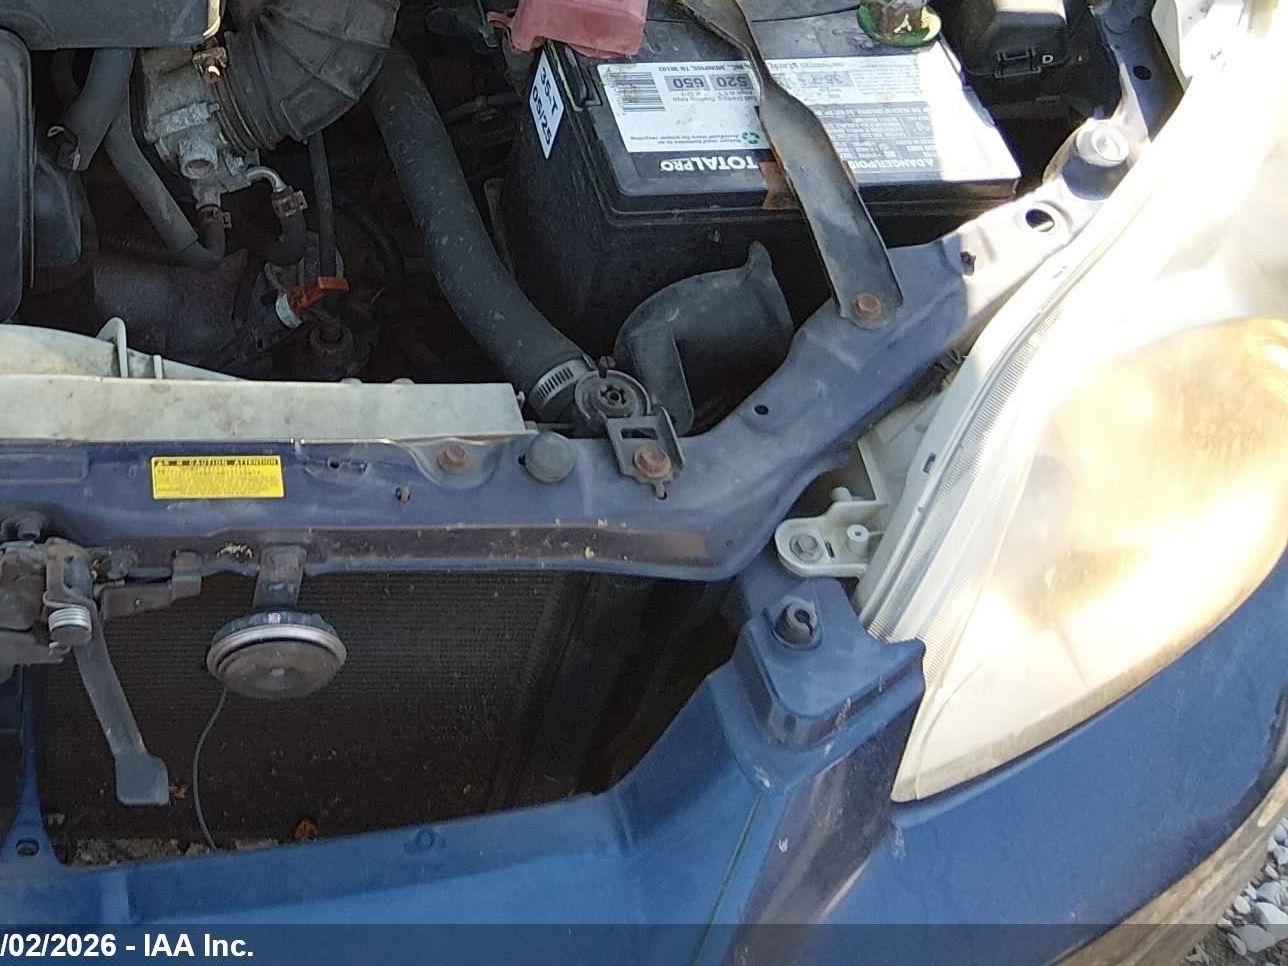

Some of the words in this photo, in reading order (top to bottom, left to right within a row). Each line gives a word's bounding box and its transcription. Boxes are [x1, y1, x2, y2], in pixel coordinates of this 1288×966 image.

[672, 77, 704, 88] 650
[716, 76, 748, 87] 520
[540, 67, 558, 116] 35-T
[532, 85, 552, 145] 05/25
[660, 155, 759, 172] TOTALPRO
